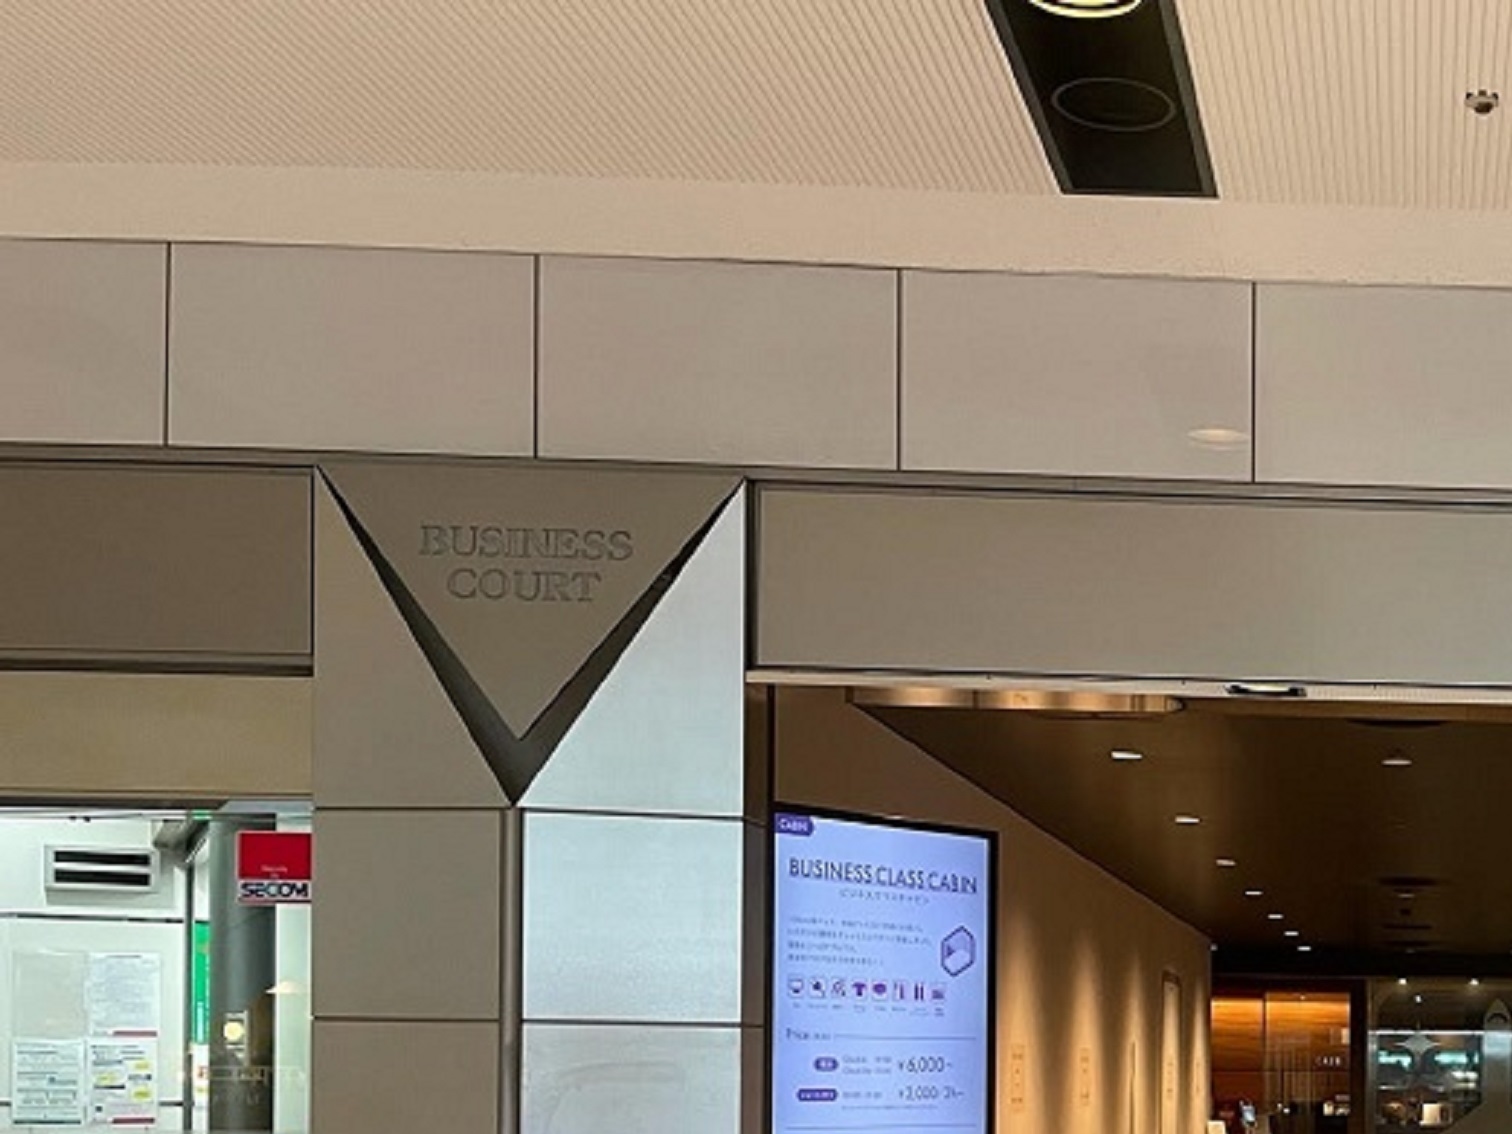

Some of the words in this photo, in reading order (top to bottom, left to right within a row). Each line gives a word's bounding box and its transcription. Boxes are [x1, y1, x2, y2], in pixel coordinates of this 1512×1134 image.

[419, 524, 633, 561] BUSINESS
[448, 568, 602, 602] COURT
[241, 883, 308, 898] SECOM
[789, 857, 872, 884] BUSINESS
[875, 866, 924, 889] CLASS
[928, 871, 977, 895] CABIN
